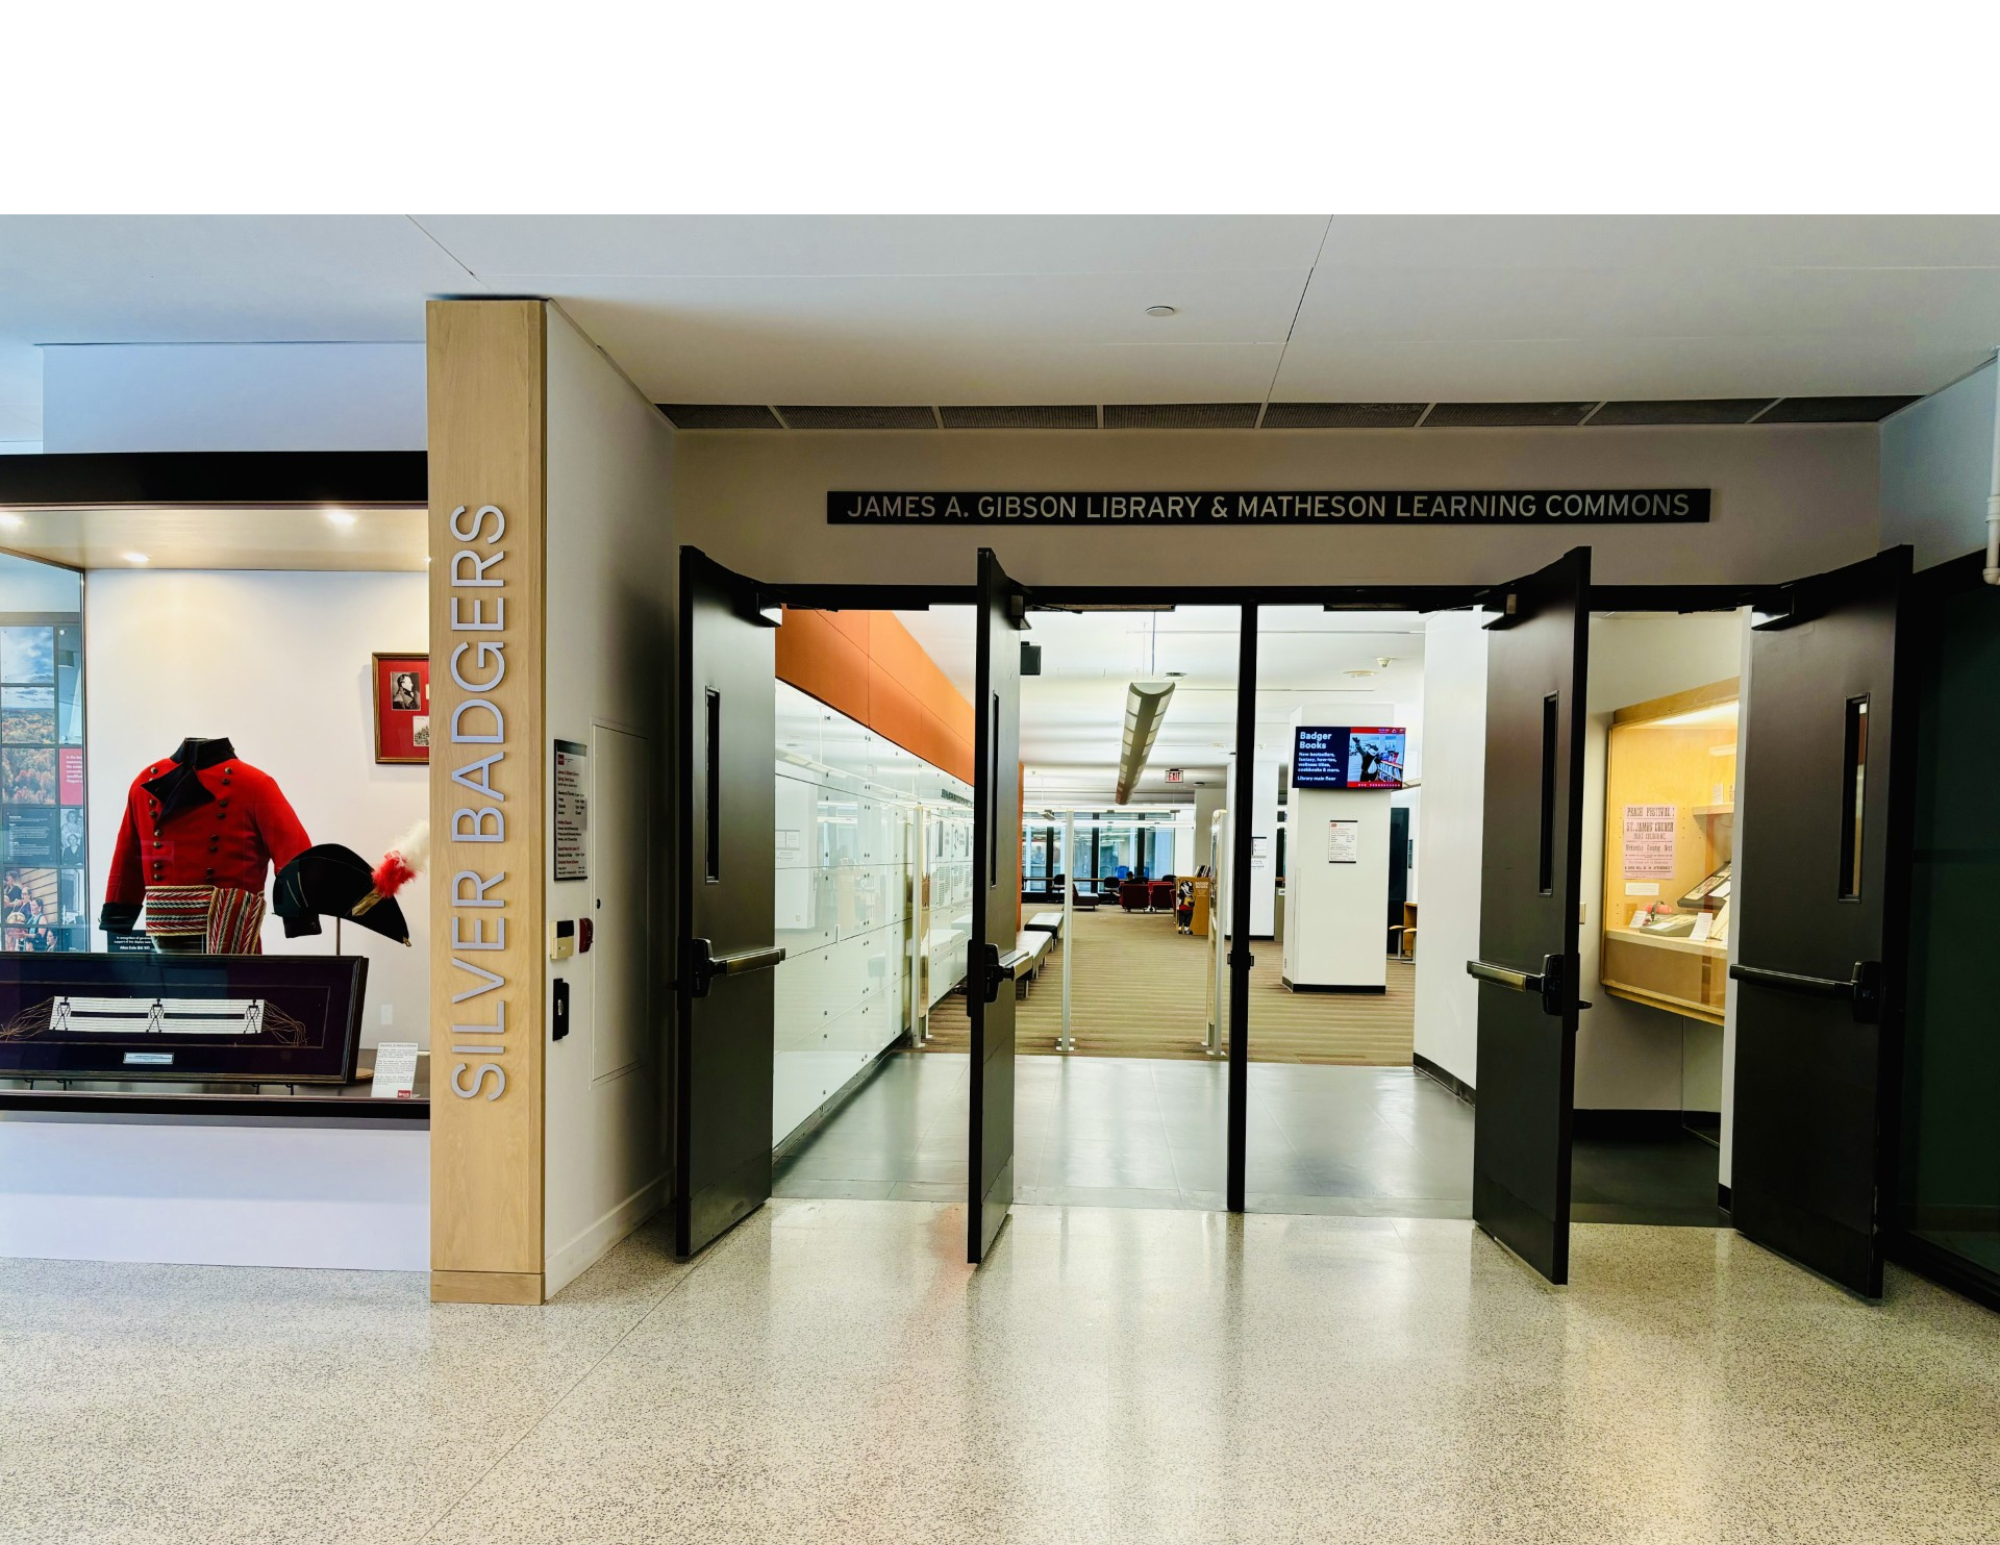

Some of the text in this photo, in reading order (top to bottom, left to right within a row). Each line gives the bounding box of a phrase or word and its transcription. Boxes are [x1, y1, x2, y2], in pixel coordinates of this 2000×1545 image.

[847, 494, 1690, 518] JAMES A. GIBSON LIBRARY & MATHESON LEARNING COMMONS
[1300, 731, 1332, 741] Badger
[1299, 741, 1327, 749] Books
[1168, 771, 1181, 782] EXIT
[449, 504, 506, 1103] SILVER BADGERS
